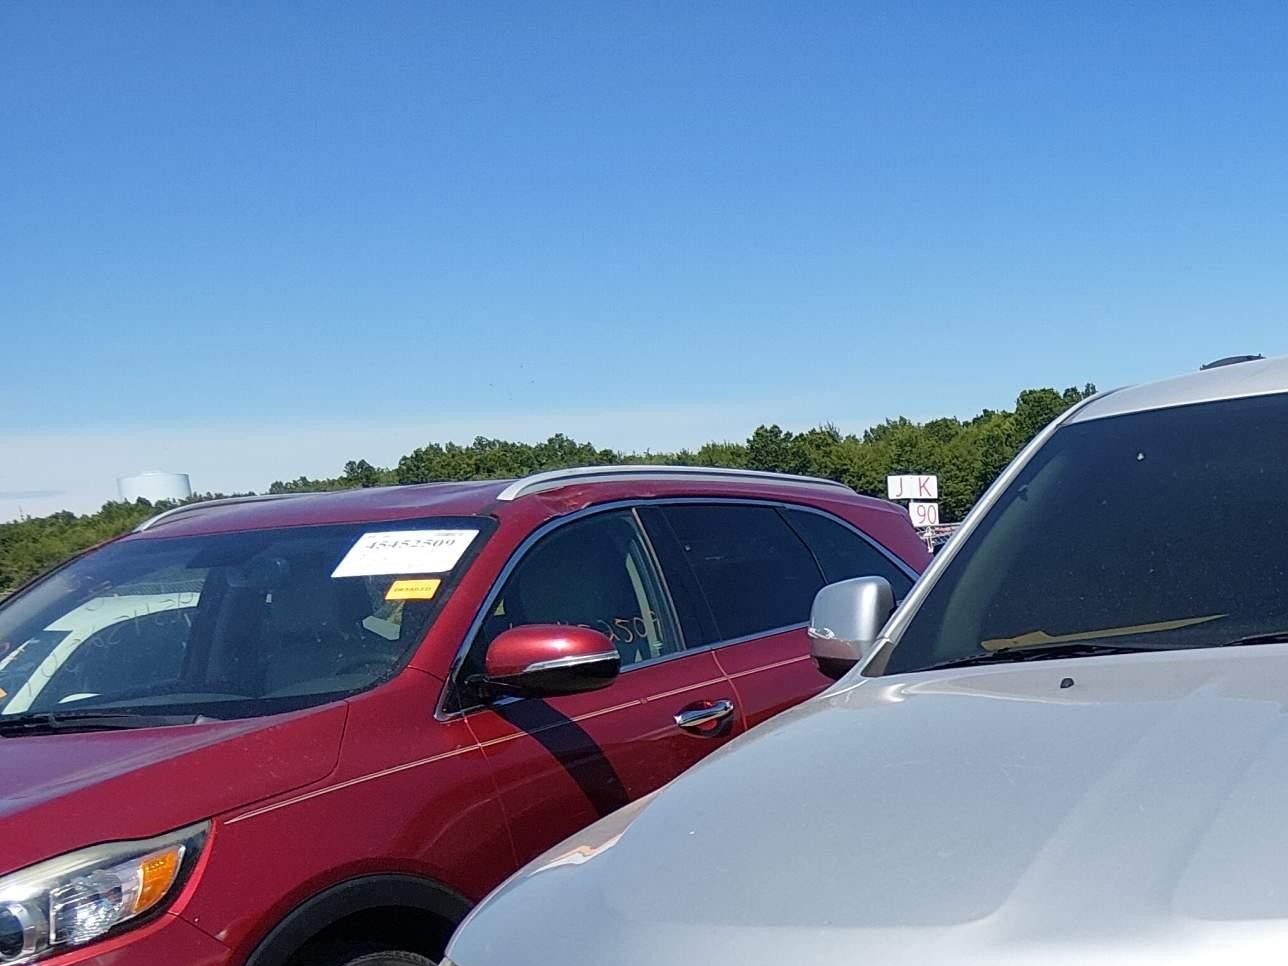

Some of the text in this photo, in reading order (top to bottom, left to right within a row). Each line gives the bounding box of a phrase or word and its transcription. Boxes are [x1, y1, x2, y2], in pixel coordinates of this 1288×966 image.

[896, 476, 932, 497] J K
[916, 504, 937, 524] 90
